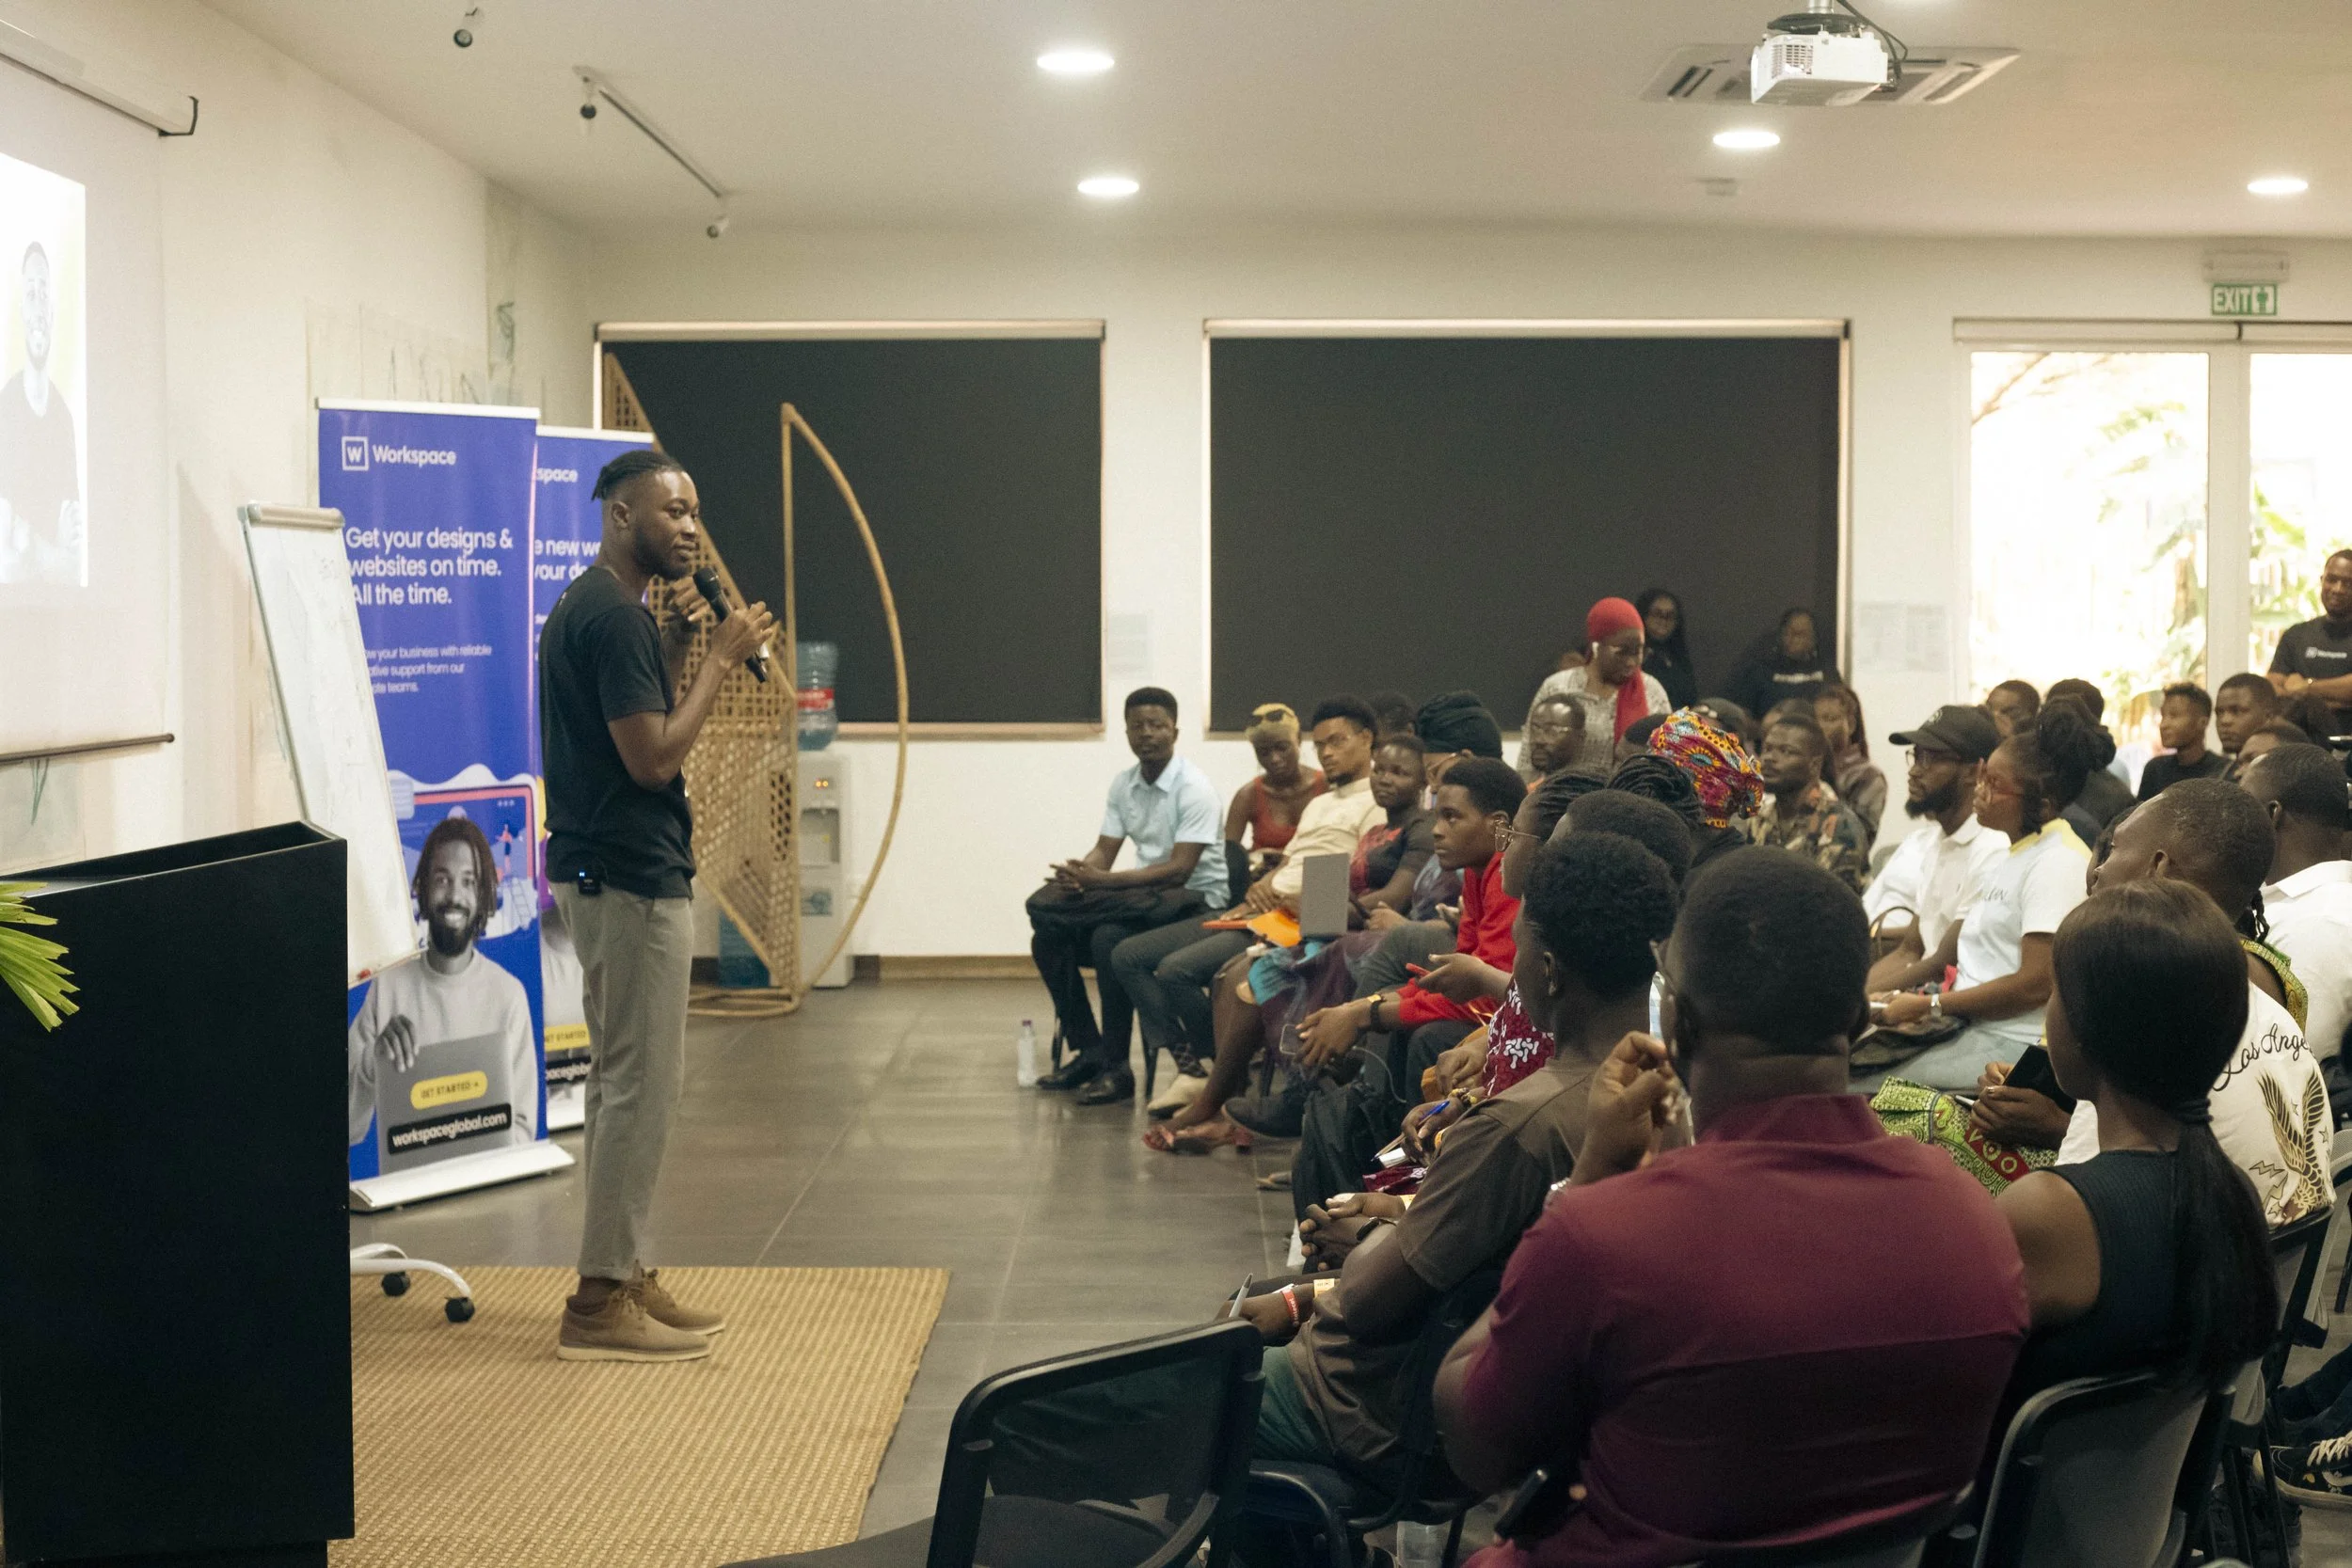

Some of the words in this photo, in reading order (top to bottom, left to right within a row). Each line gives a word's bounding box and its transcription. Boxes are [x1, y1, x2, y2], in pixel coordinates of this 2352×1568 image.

[2214, 286, 2251, 313] EXIT
[372, 444, 457, 468] Workspace
[345, 527, 379, 548] Get
[383, 531, 423, 555] your
[426, 526, 497, 556] designs
[499, 528, 514, 548] &
[546, 540, 580, 557] new
[349, 555, 427, 578] websites
[430, 559, 453, 577] on
[456, 556, 502, 577] time.
[353, 583, 372, 605] All
[374, 583, 405, 605] the
[407, 582, 453, 605] time.
[377, 648, 398, 661] your
[399, 646, 439, 658] business
[441, 645, 459, 657] with
[390, 663, 426, 679] support
[427, 662, 450, 674] from
[451, 663, 466, 673] our
[437, 1083, 470, 1095] STARTED
[392, 1113, 508, 1148] workspaceglobal.com
